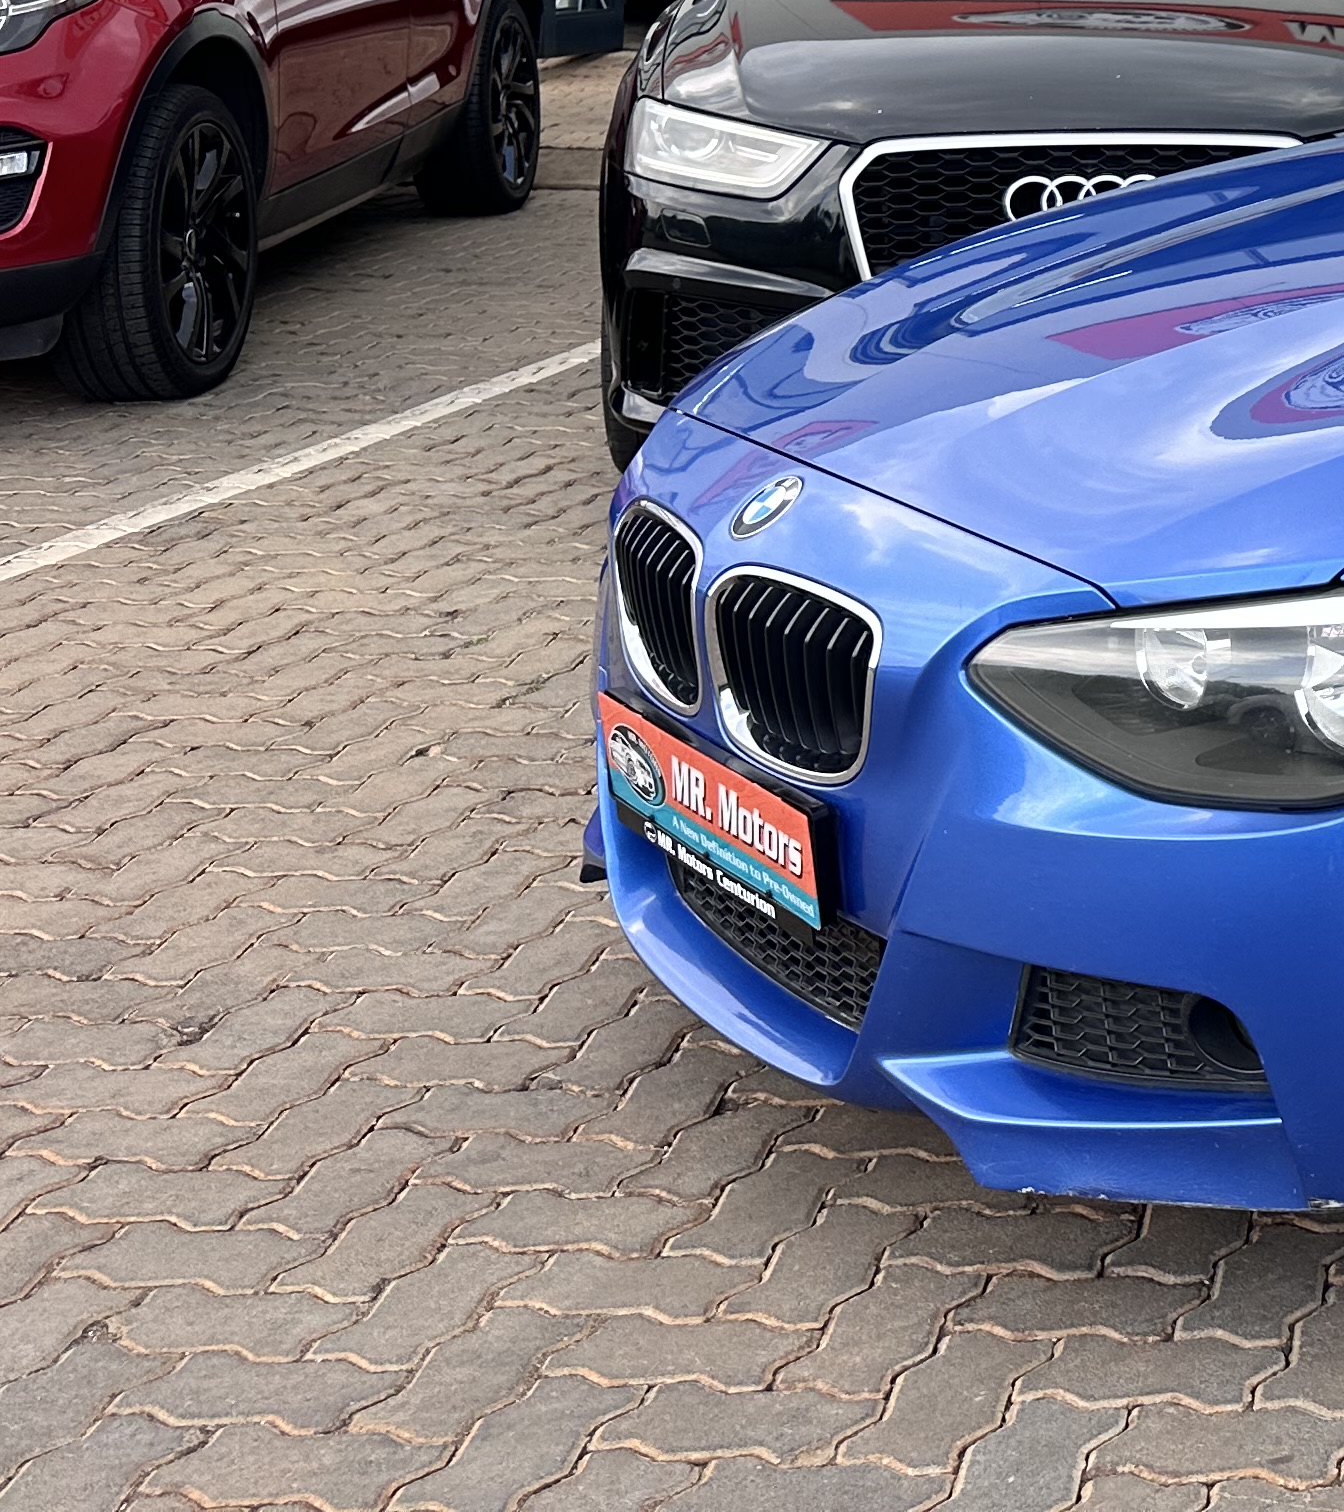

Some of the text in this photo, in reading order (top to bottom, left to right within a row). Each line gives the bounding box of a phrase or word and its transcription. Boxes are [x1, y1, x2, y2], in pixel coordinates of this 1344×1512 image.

[671, 754, 713, 821] MR.
[718, 782, 804, 879] Motors
[672, 815, 815, 919] A New Definition to Pre-Owned
[657, 830, 777, 920] MR. Motors Centurion
